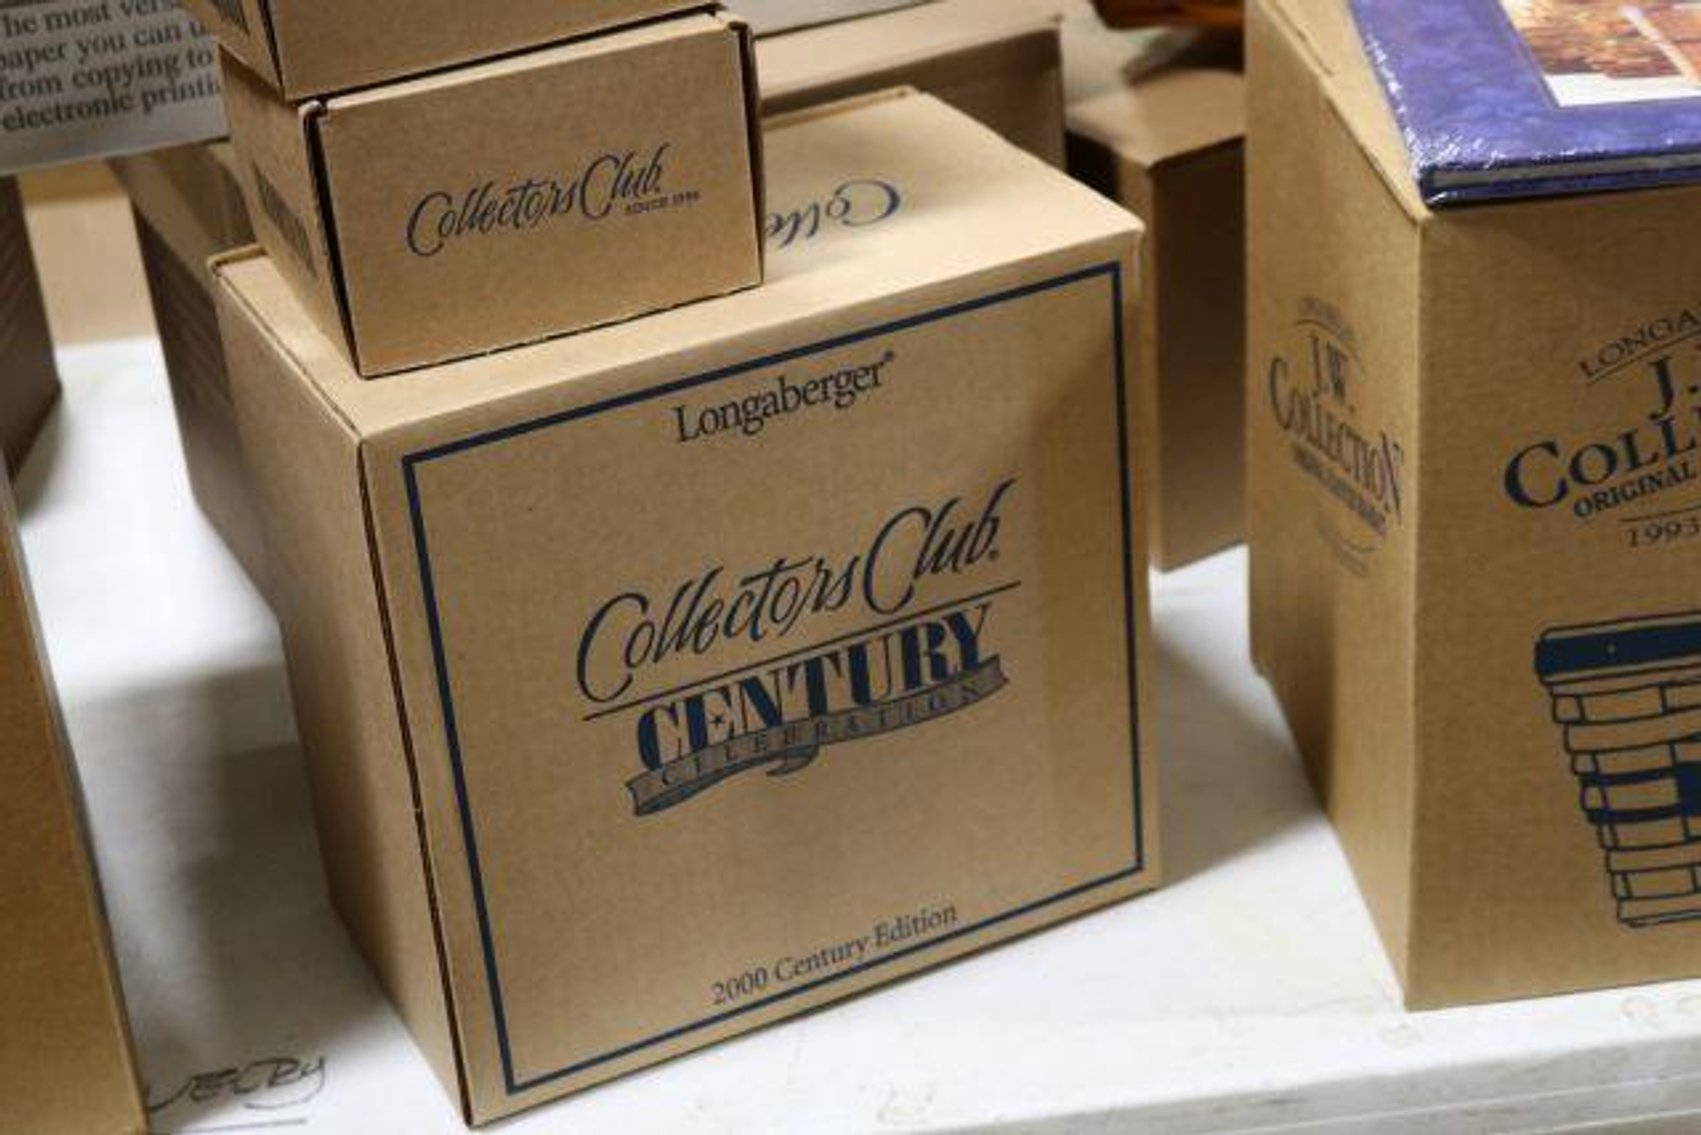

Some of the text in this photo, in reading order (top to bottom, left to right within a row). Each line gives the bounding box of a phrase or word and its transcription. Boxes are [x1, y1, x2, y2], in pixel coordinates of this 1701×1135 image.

[44, 2, 111, 32] most
[76, 33, 126, 63] you
[133, 24, 182, 47] can
[72, 50, 181, 95] copying
[186, 45, 214, 68] to
[3, 91, 135, 130] electronic
[407, 178, 578, 256] Collectors
[1504, 405, 1701, 509] COLL
[1573, 461, 1697, 518] ORIGINAL
[576, 555, 861, 703] Collectors
[636, 602, 993, 774] CENTURY
[710, 903, 958, 1005] 2000 Century Edition
